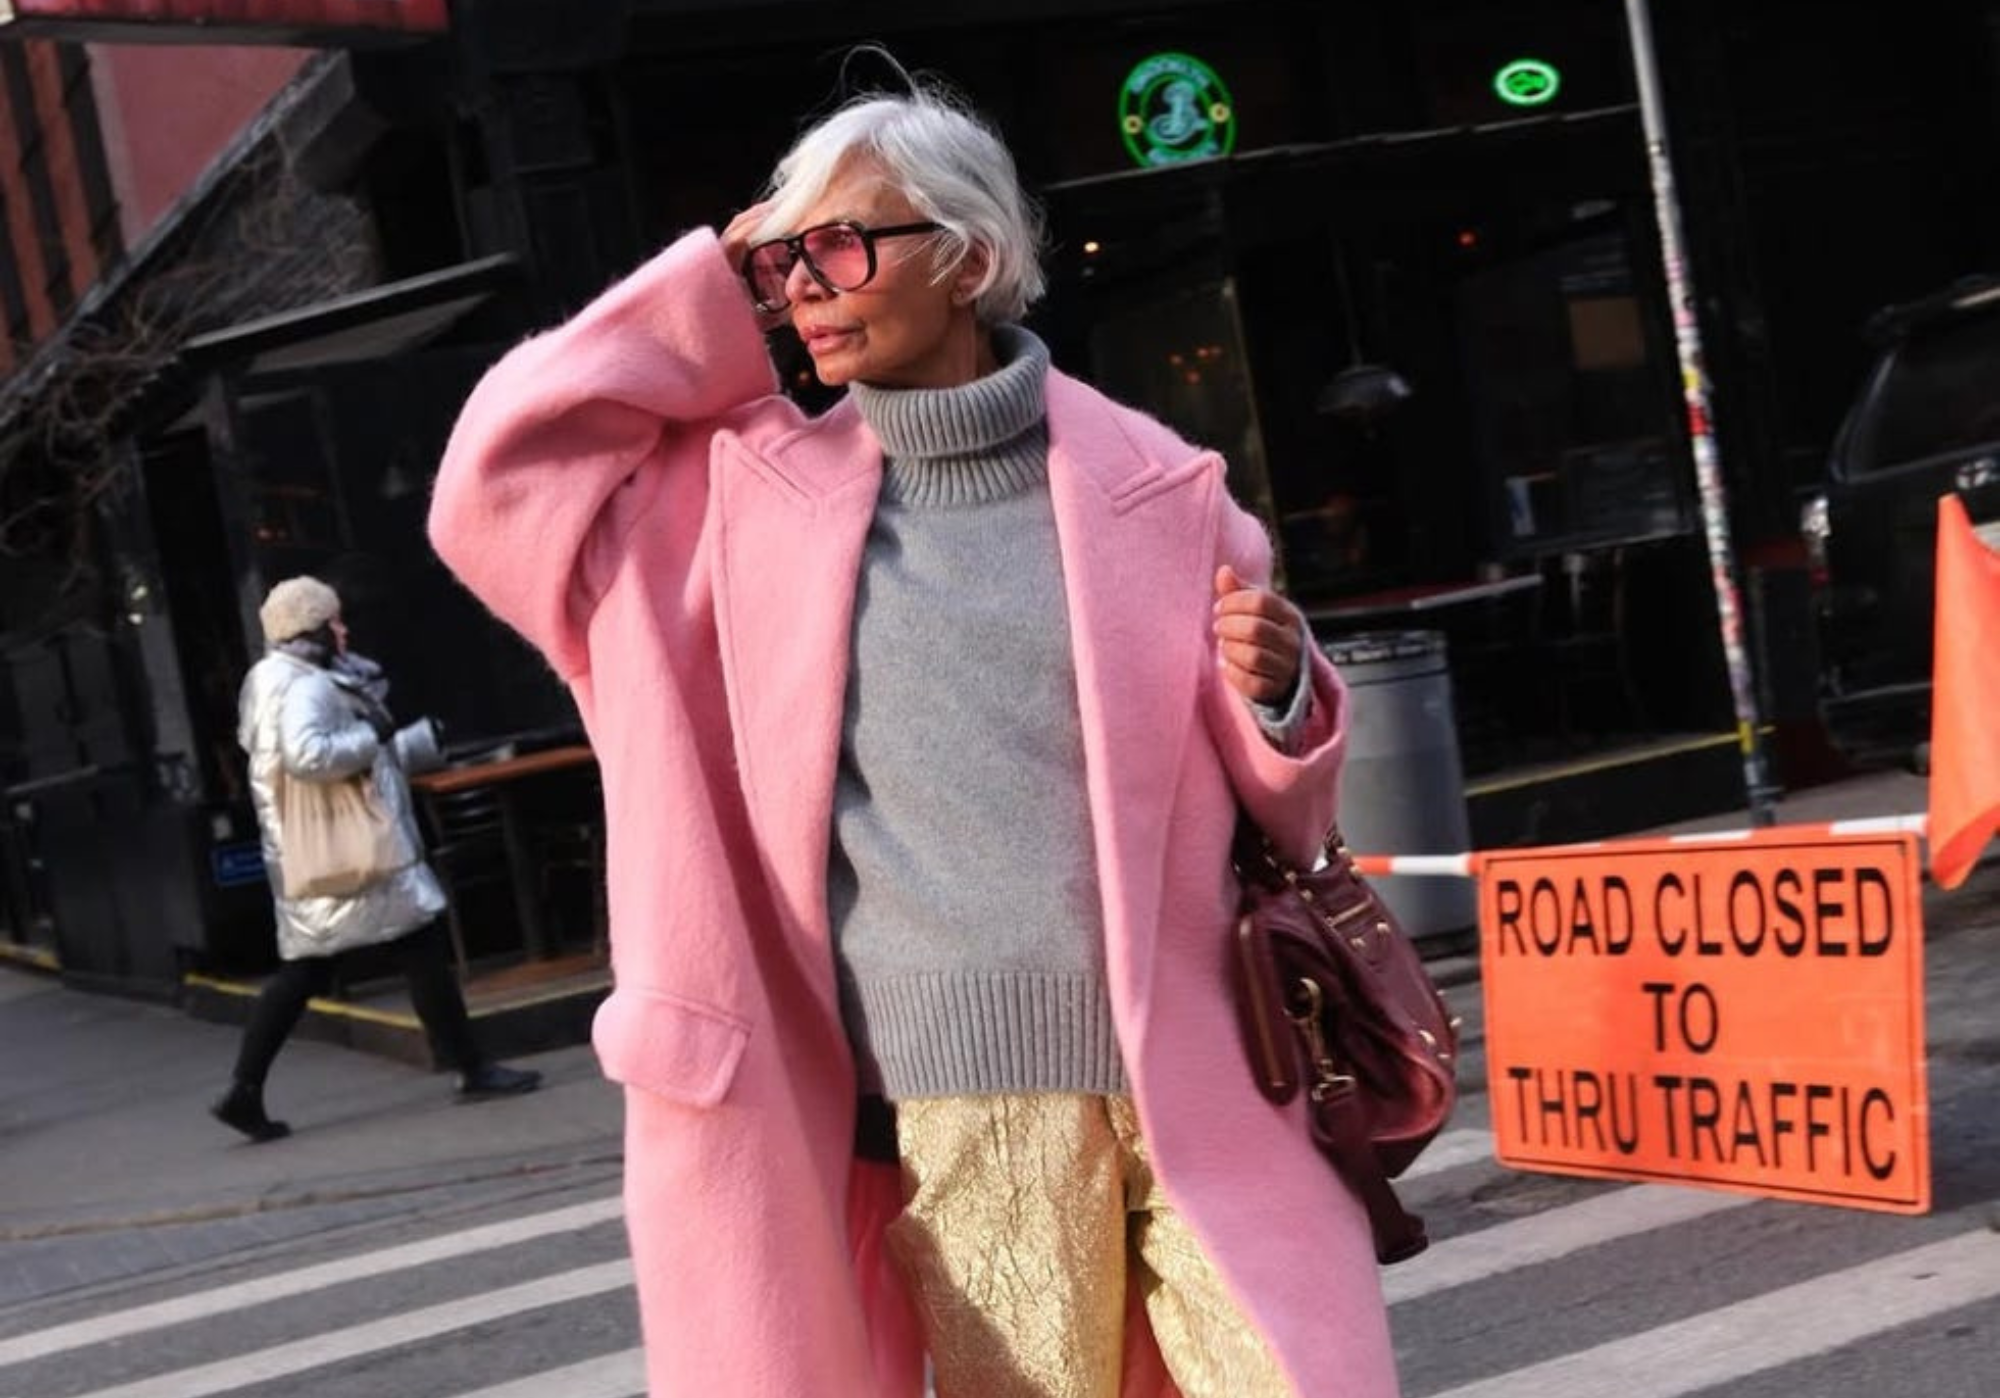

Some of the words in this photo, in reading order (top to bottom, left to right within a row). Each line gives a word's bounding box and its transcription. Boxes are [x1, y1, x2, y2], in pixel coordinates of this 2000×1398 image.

[1498, 876, 1633, 956] ROAD
[1655, 867, 1893, 957] CLOSED
[1643, 983, 1718, 1054] TO
[1508, 1067, 1638, 1155] THRU
[1653, 1075, 1895, 1181] TRAFFIC
